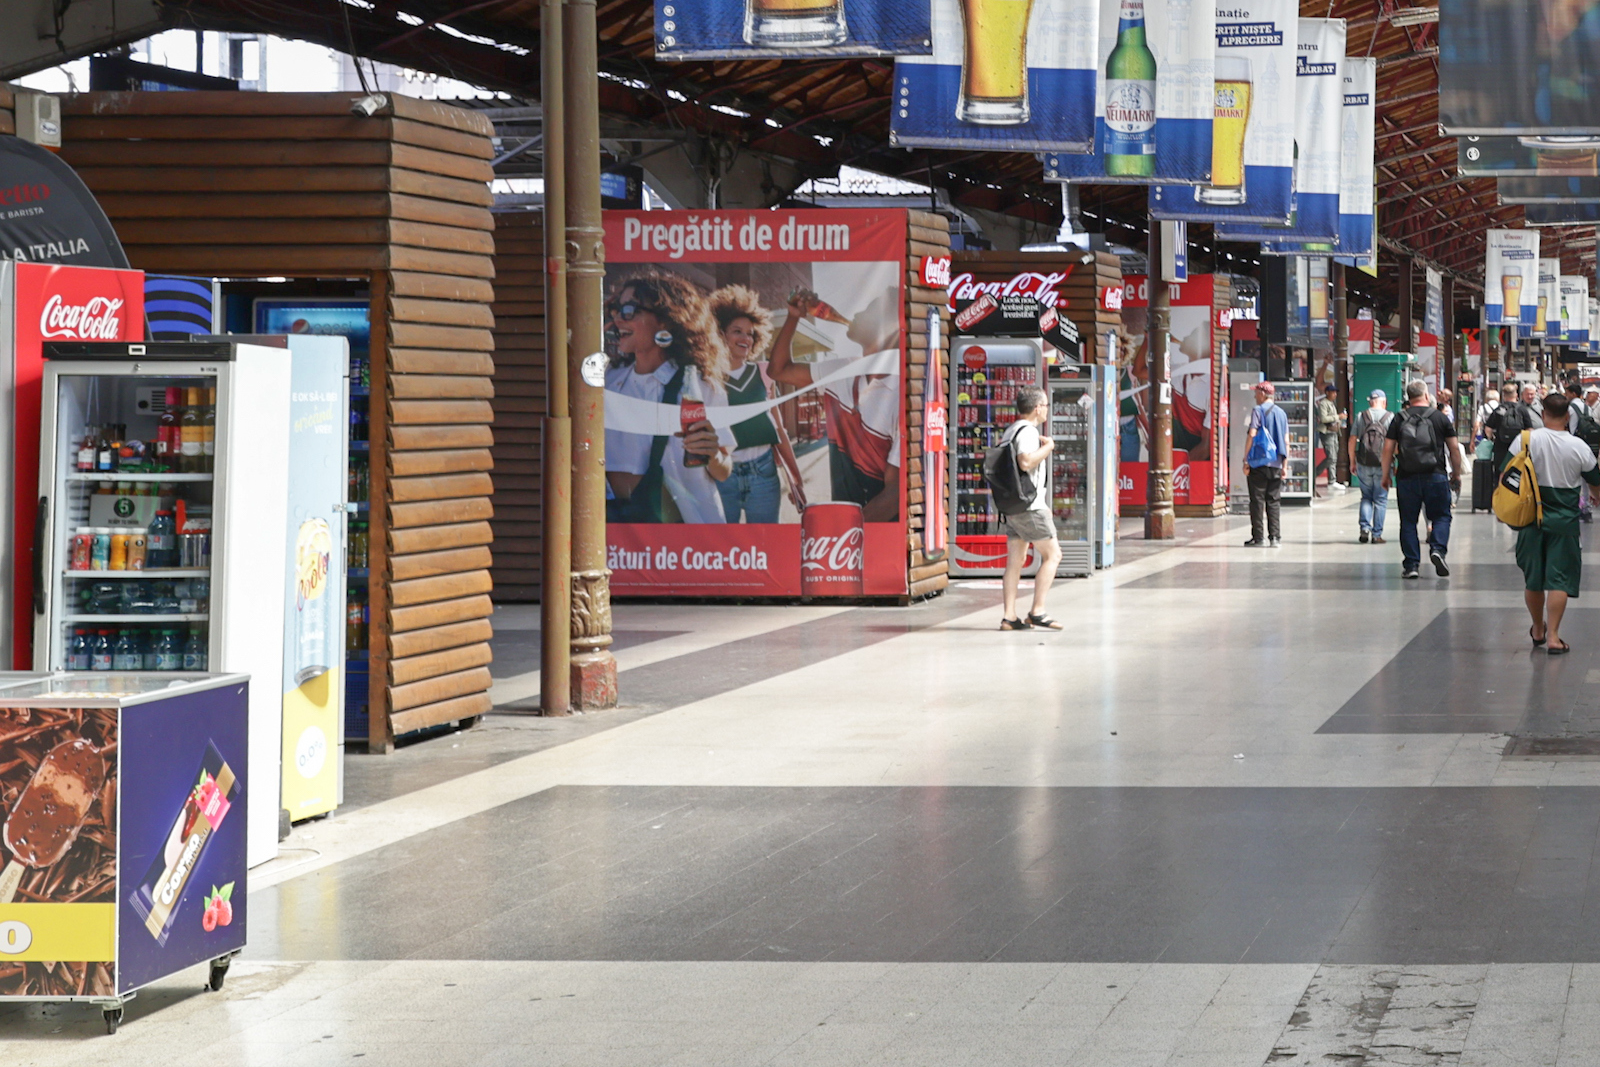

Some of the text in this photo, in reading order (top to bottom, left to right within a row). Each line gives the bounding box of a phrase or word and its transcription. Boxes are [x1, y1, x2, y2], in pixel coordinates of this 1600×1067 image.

[1215, 9, 1250, 20] inație
[1221, 35, 1281, 46] APRECIERE
[1297, 43, 1318, 51] ntru
[1104, 101, 1156, 123] NEUMARKT
[1214, 108, 1244, 119] UMARKT
[0, 182, 51, 205] etto
[8, 207, 45, 219] BARISTA
[624, 216, 850, 259] Pregătit de drum
[29, 237, 91, 261] ITALIA
[1003, 296, 1021, 304] Look
[40, 294, 124, 340] Coca-Cola
[606, 545, 767, 571] ături de Coca-Cola
[801, 526, 864, 571] ca-Col
